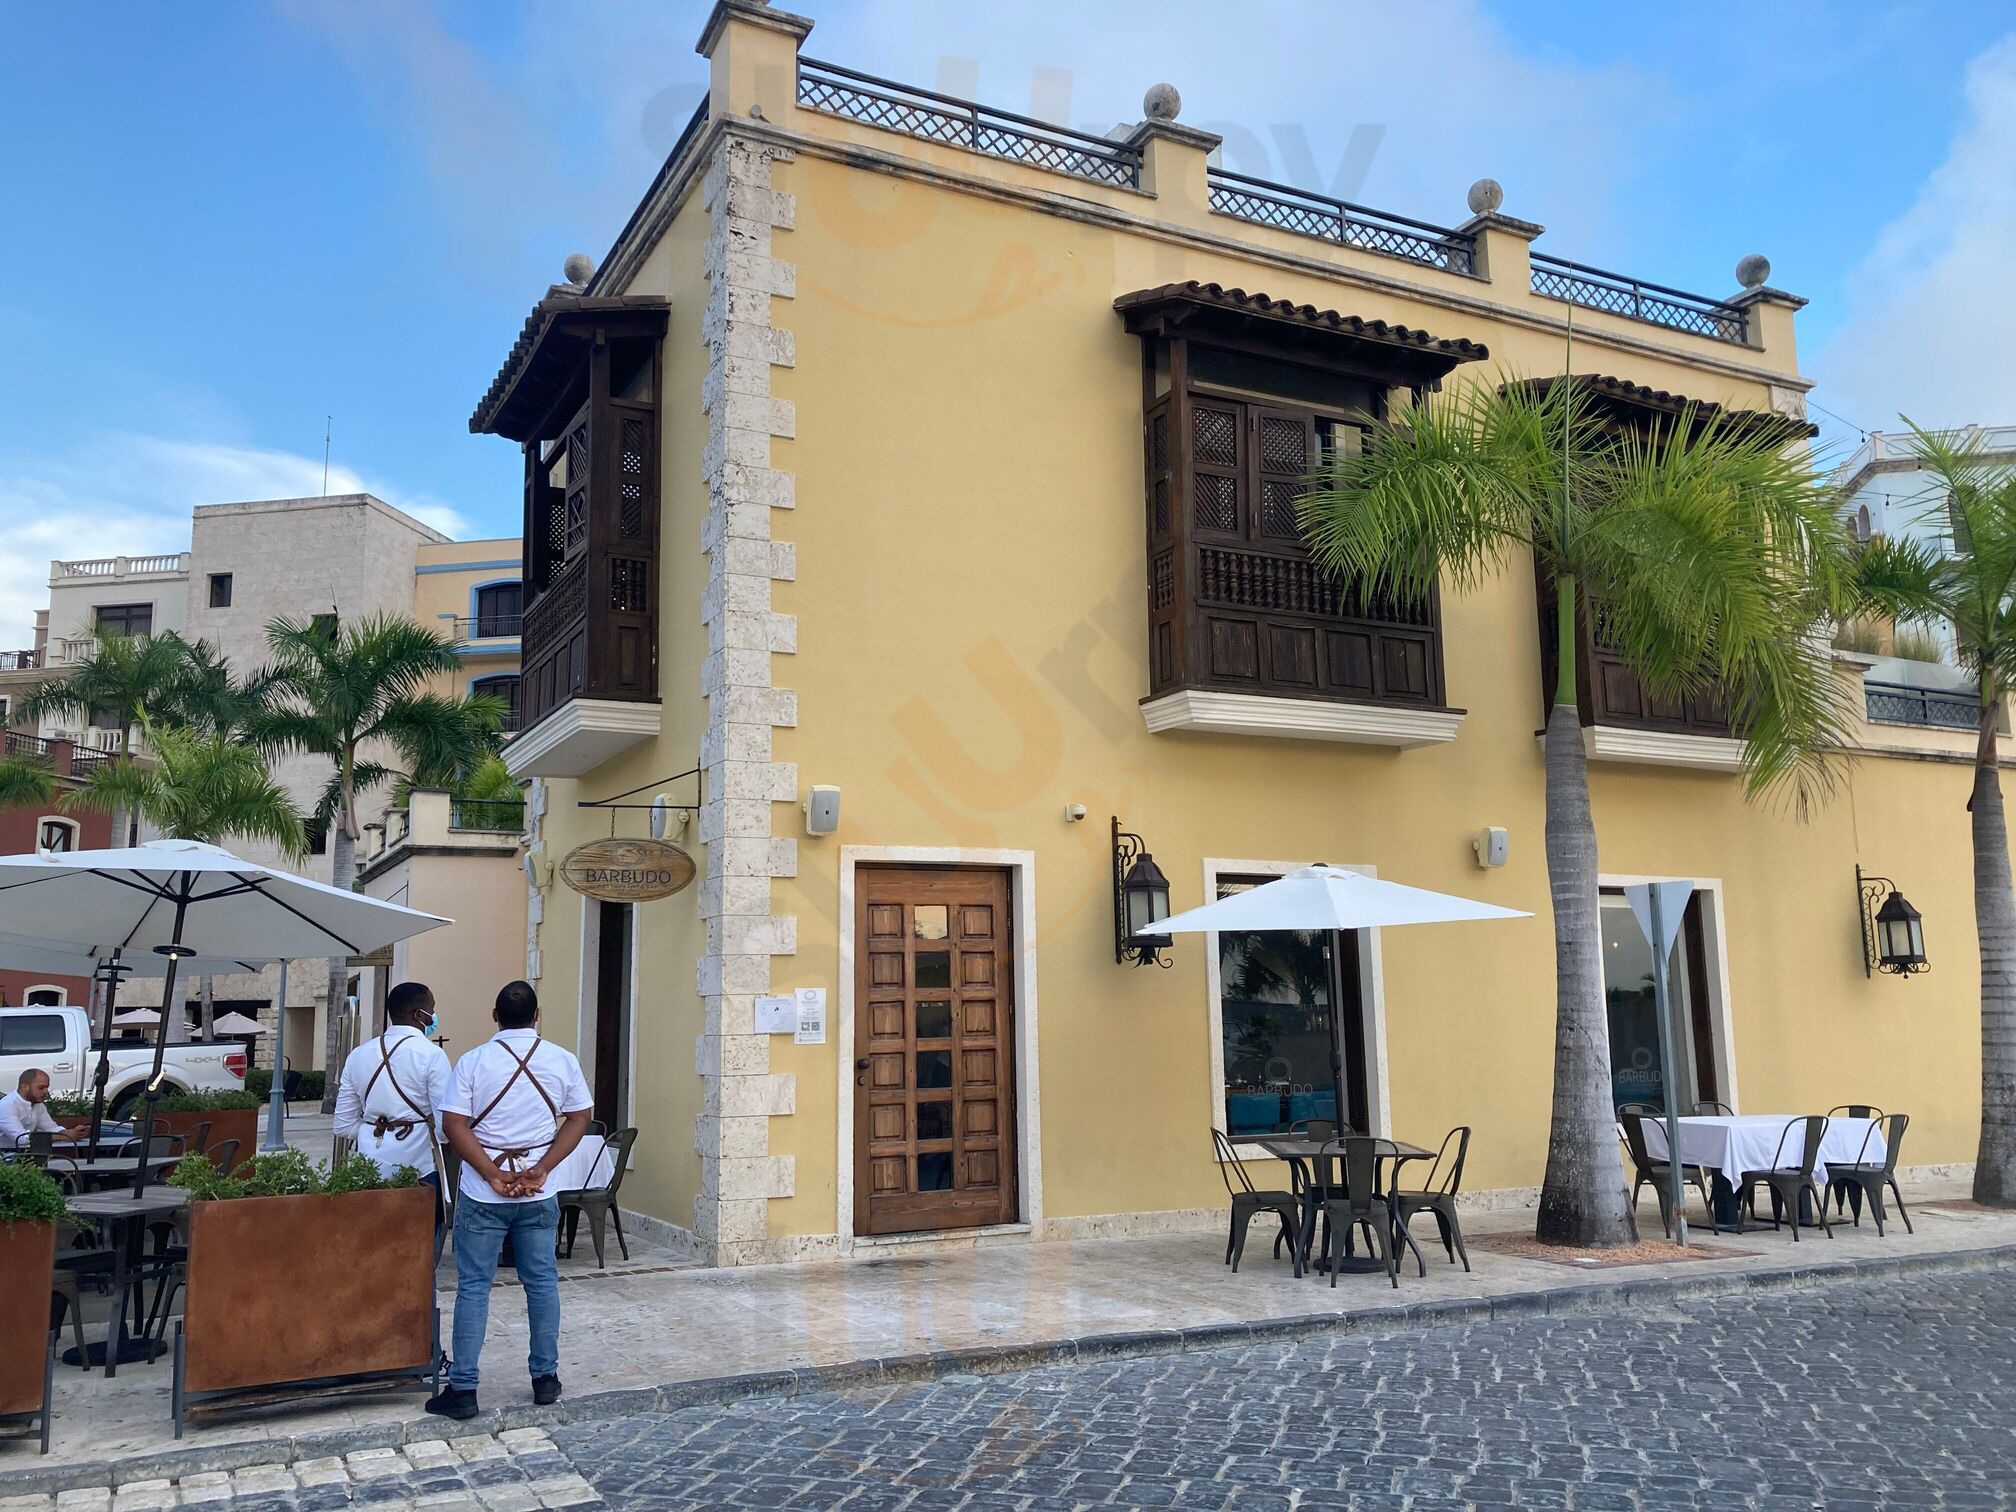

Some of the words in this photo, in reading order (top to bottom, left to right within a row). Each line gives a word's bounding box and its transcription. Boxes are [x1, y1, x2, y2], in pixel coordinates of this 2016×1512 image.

[586, 869, 671, 884] BARBUDO
[1619, 1071, 1661, 1082] BARBUD
[1247, 1084, 1313, 1097] BARBUDO
